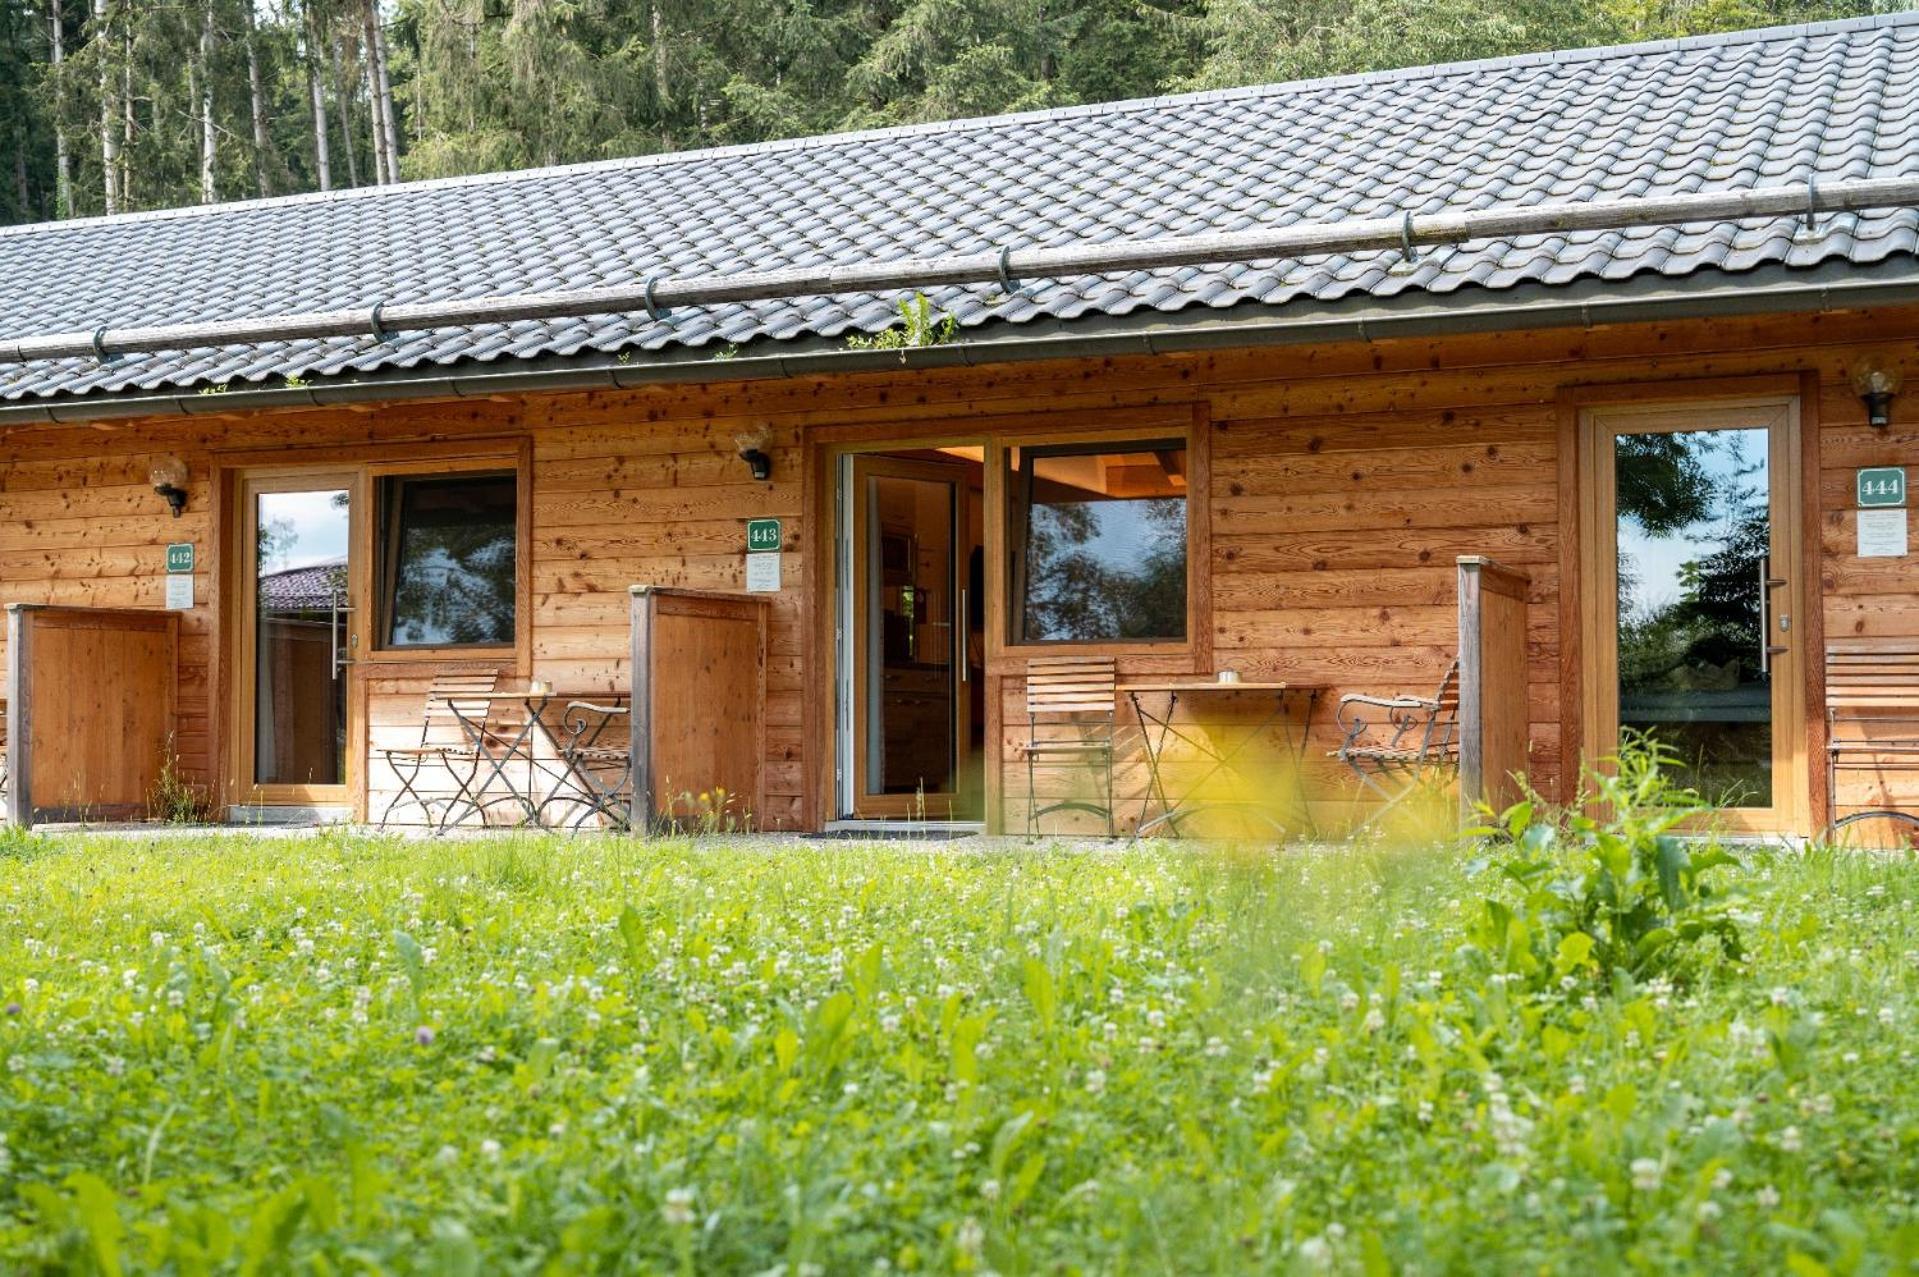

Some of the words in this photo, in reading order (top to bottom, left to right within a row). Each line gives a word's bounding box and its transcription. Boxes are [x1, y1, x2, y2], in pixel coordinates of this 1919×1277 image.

[1862, 480, 1898, 496] 444
[751, 528, 777, 542] 443
[170, 552, 191, 564] 442
